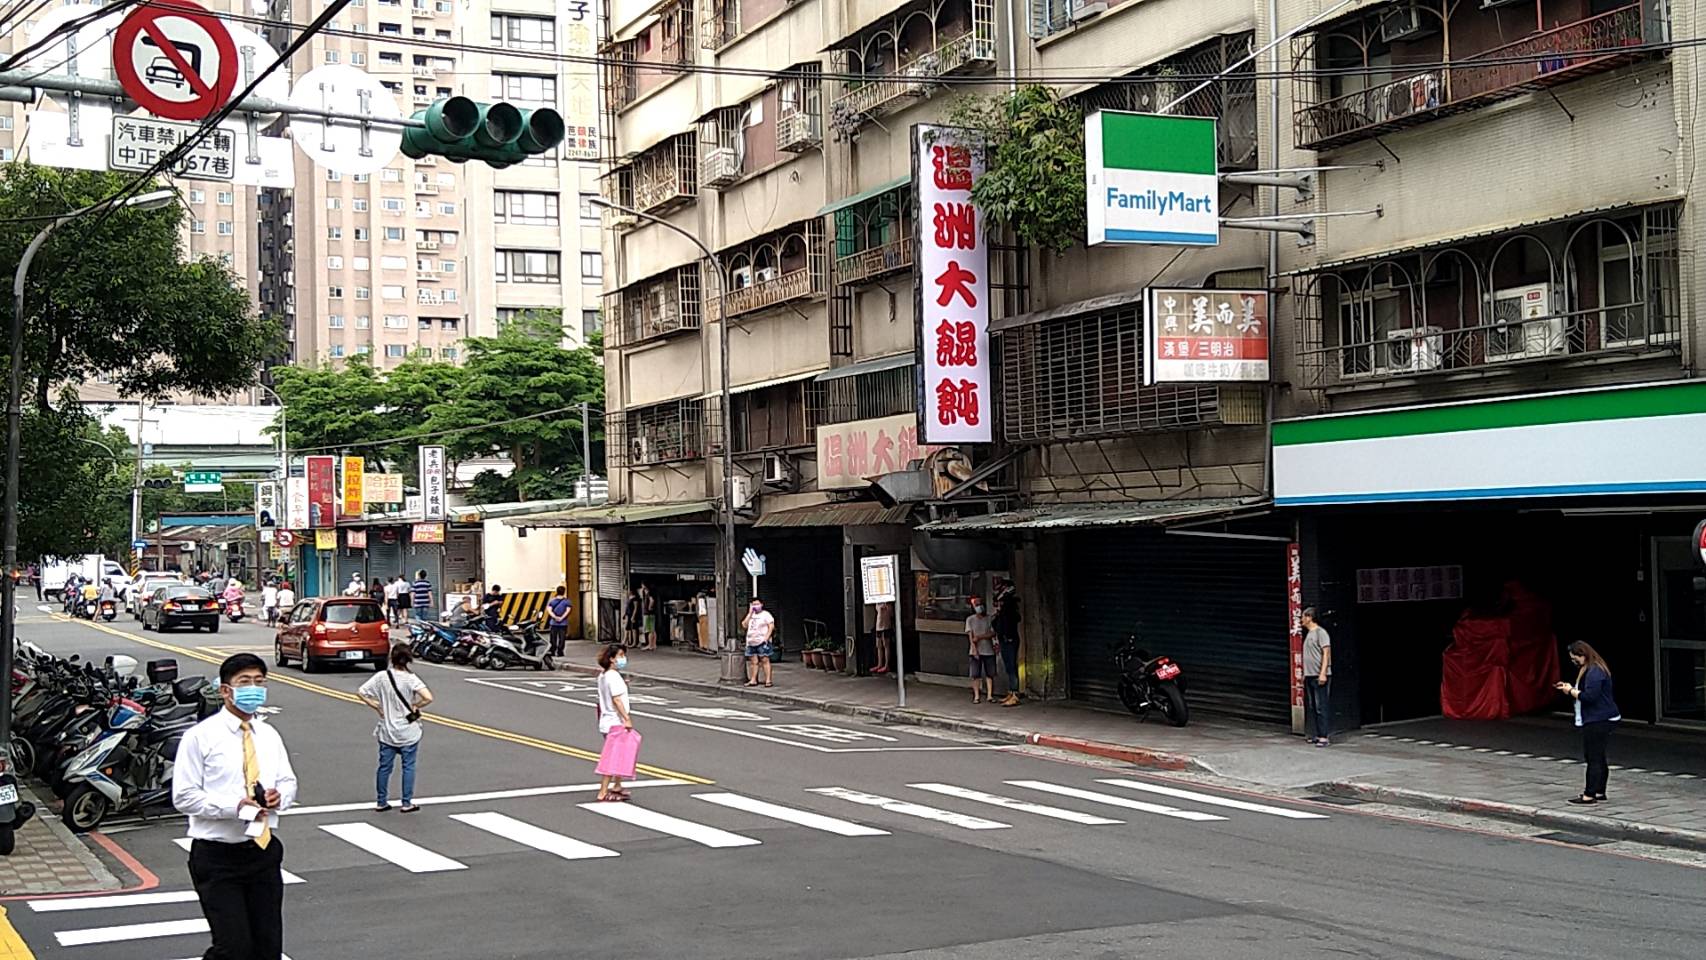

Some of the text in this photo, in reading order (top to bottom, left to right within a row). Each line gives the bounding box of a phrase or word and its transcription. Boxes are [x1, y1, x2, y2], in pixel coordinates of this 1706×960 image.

[1107, 187, 1211, 216] FamilyMart
[1188, 296, 1262, 334] 美而美
